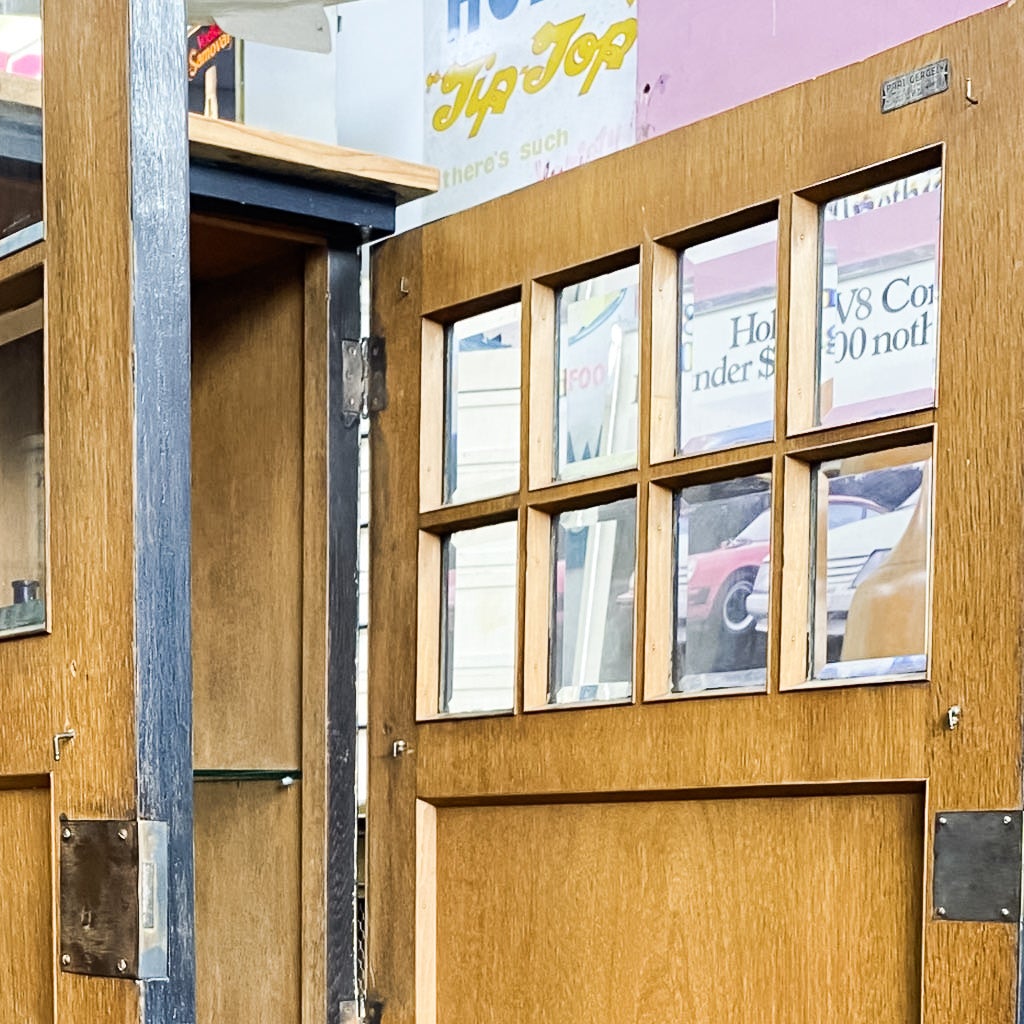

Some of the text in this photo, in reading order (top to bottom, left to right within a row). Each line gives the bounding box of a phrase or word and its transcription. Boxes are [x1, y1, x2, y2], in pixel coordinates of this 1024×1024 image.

[443, 128, 569, 188] there's such
[836, 287, 873, 324] V8
